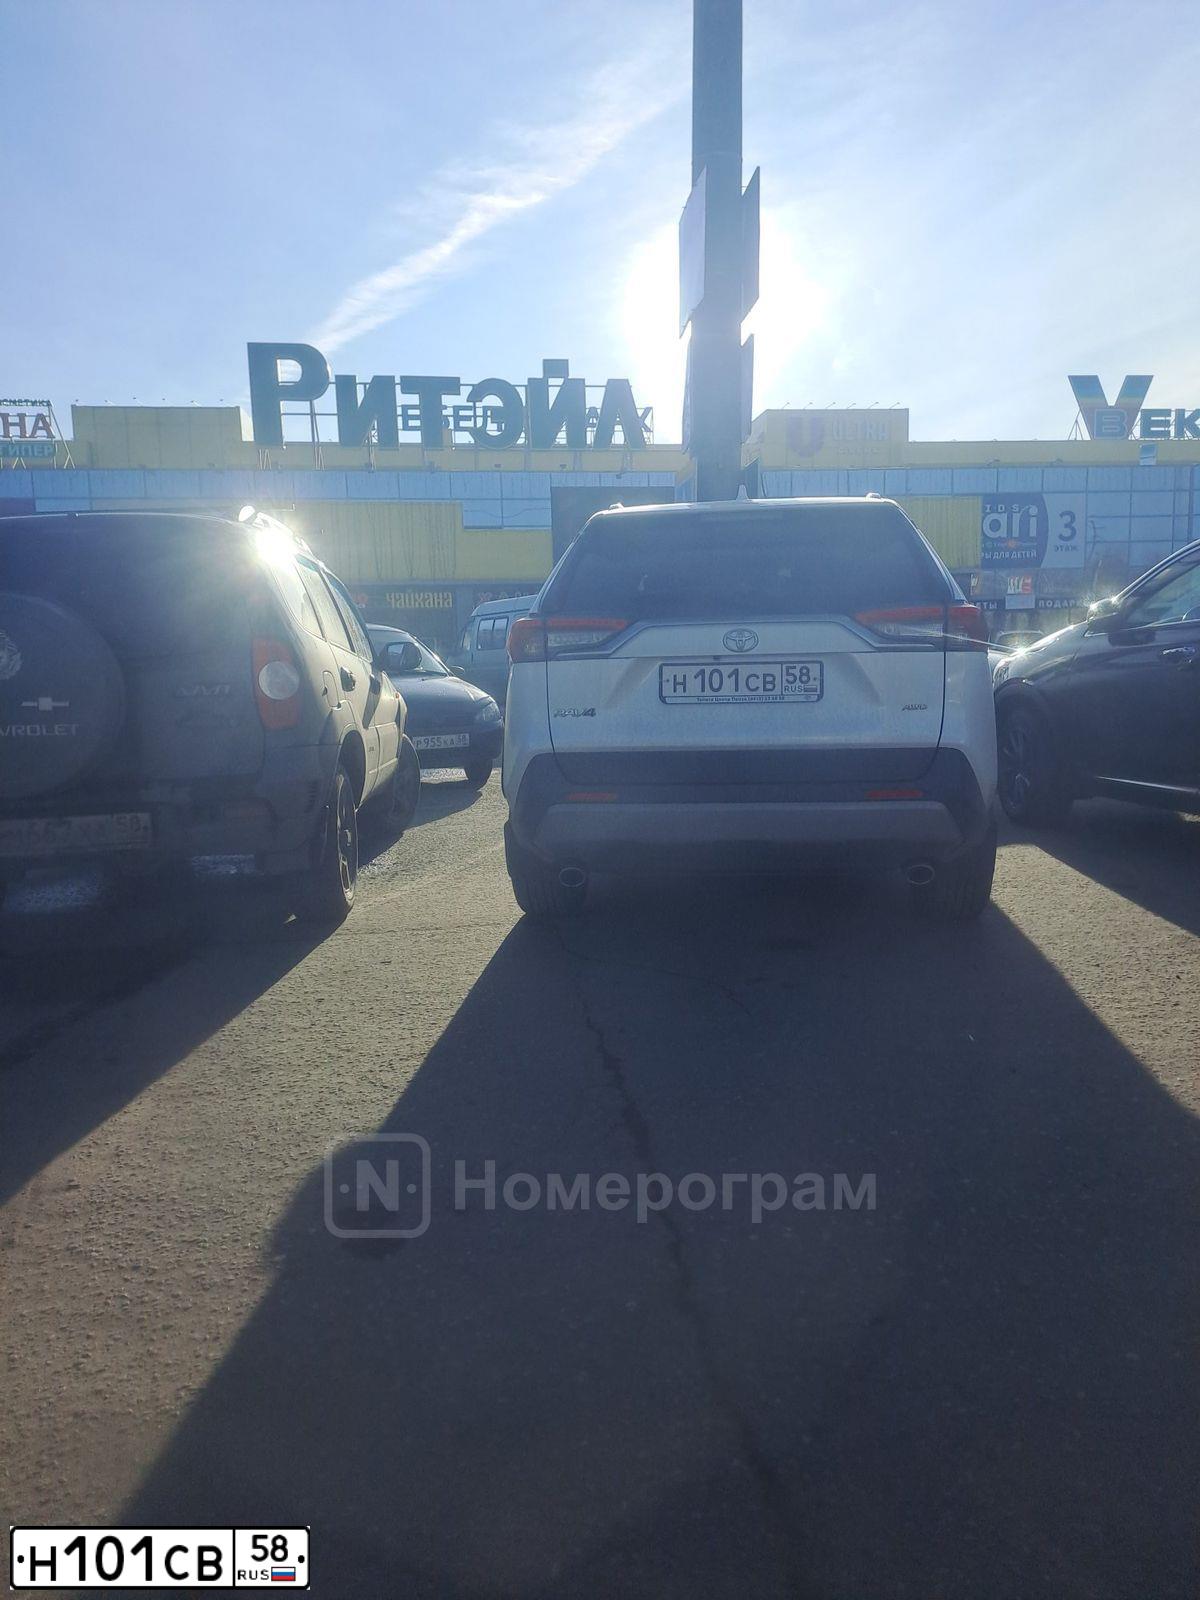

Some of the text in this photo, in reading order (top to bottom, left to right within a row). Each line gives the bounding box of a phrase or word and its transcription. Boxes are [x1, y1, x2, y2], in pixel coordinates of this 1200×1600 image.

[1057, 511, 1078, 542] 3
[672, 666, 811, 693] Н101СВ 58
[784, 686, 802, 694] RUS
